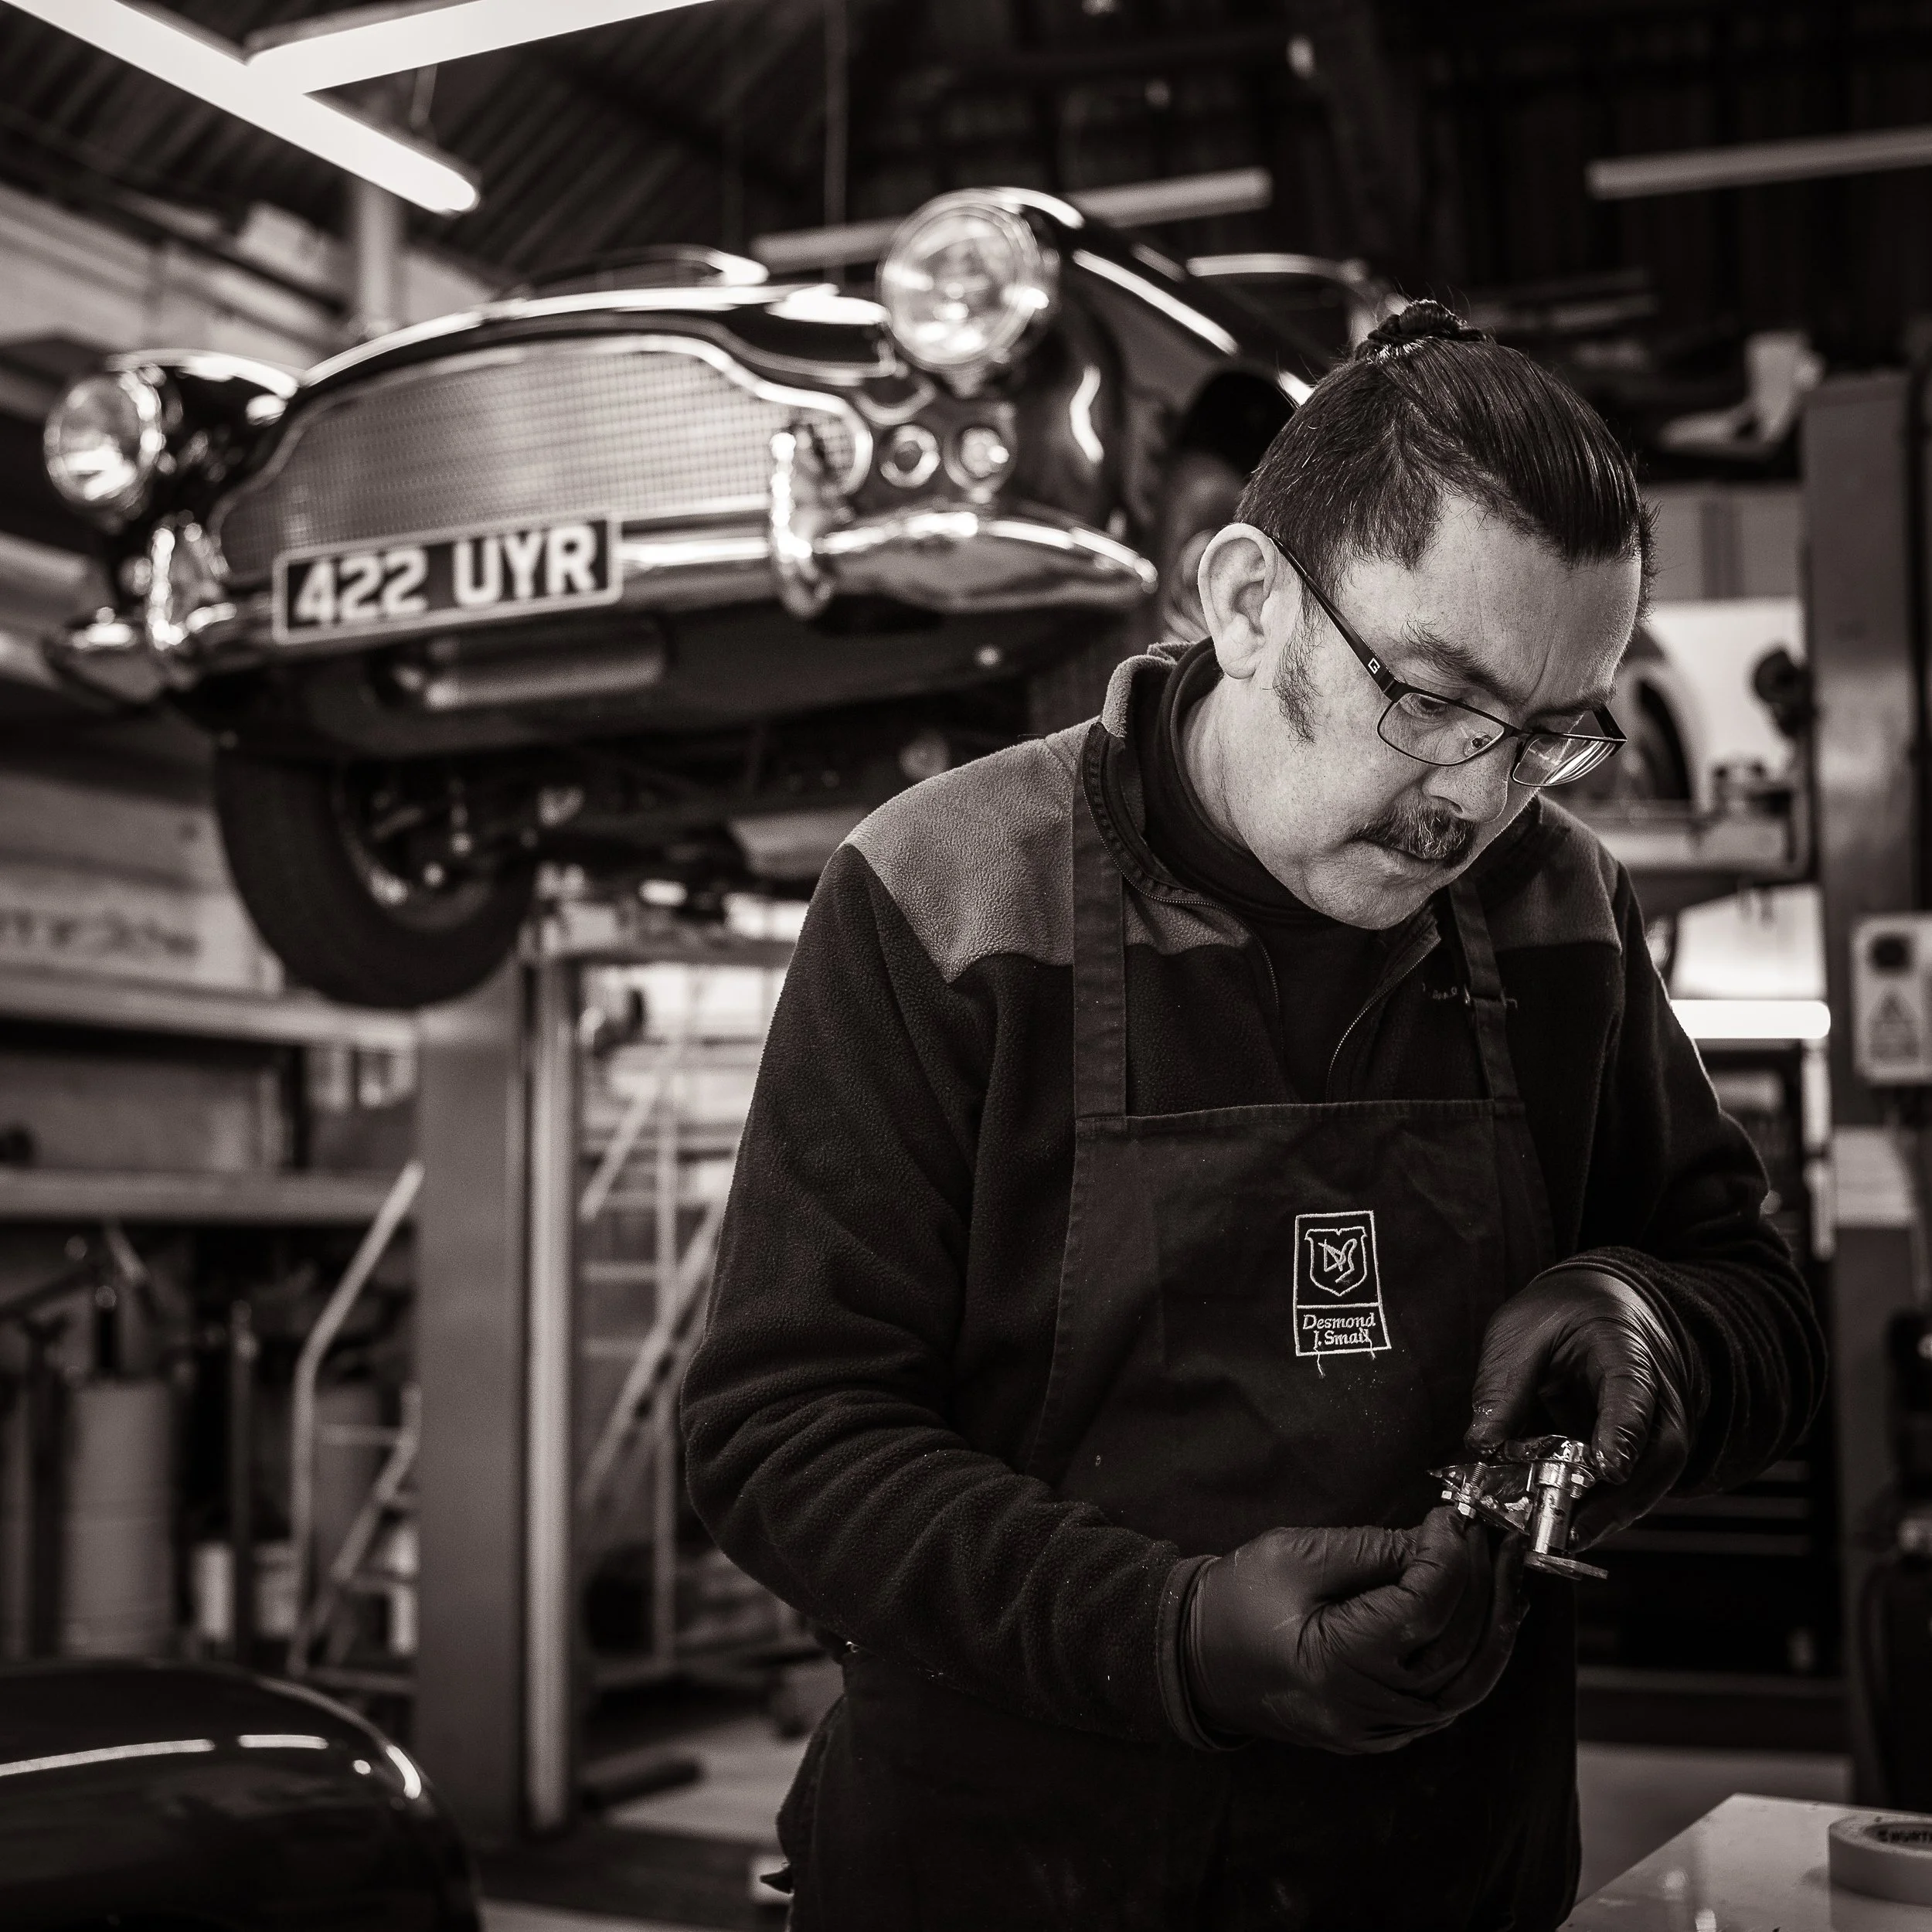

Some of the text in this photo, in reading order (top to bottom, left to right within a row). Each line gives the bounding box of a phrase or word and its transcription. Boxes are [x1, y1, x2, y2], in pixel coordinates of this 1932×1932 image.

[295, 523, 597, 627] 422 UYR
[1302, 1312, 1376, 1330] Desmond
